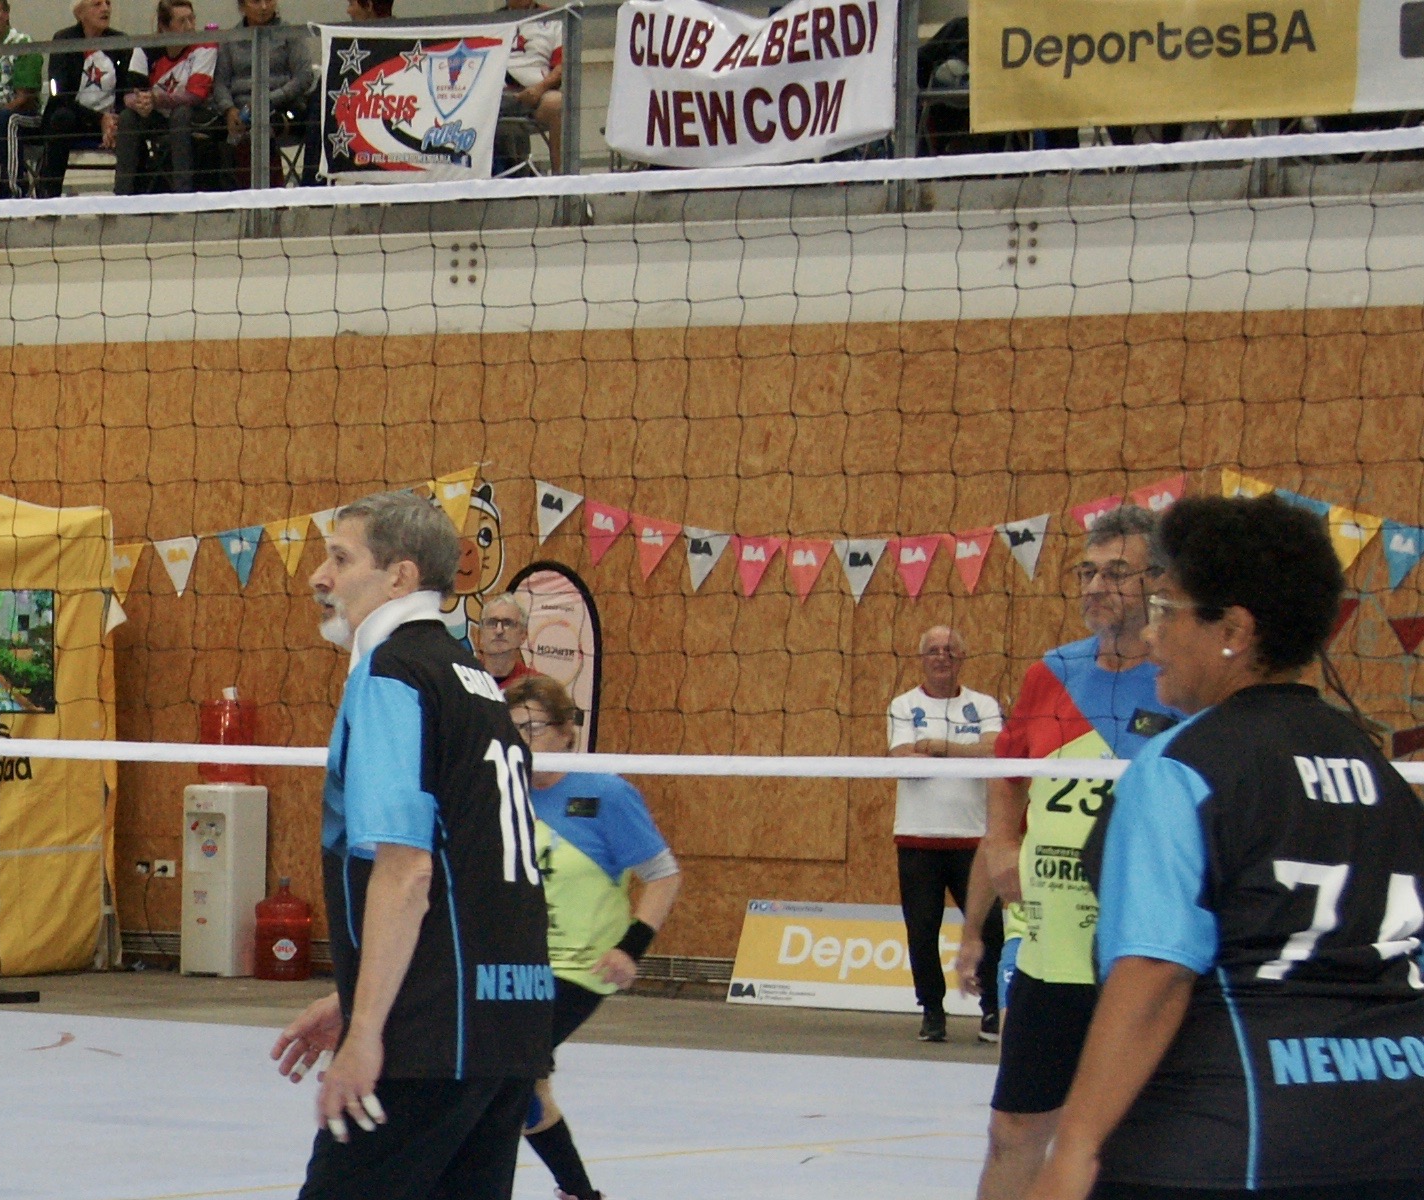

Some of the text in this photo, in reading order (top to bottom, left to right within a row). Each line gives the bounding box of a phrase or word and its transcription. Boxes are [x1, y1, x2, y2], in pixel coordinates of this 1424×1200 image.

[629, 1, 878, 72] CLUB ALBERDI
[1001, 9, 1316, 79] DeportesBA
[646, 79, 846, 148] NEWCOM
[848, 551, 874, 568] BA
[911, 707, 927, 728] 2
[1293, 756, 1378, 806] PATO
